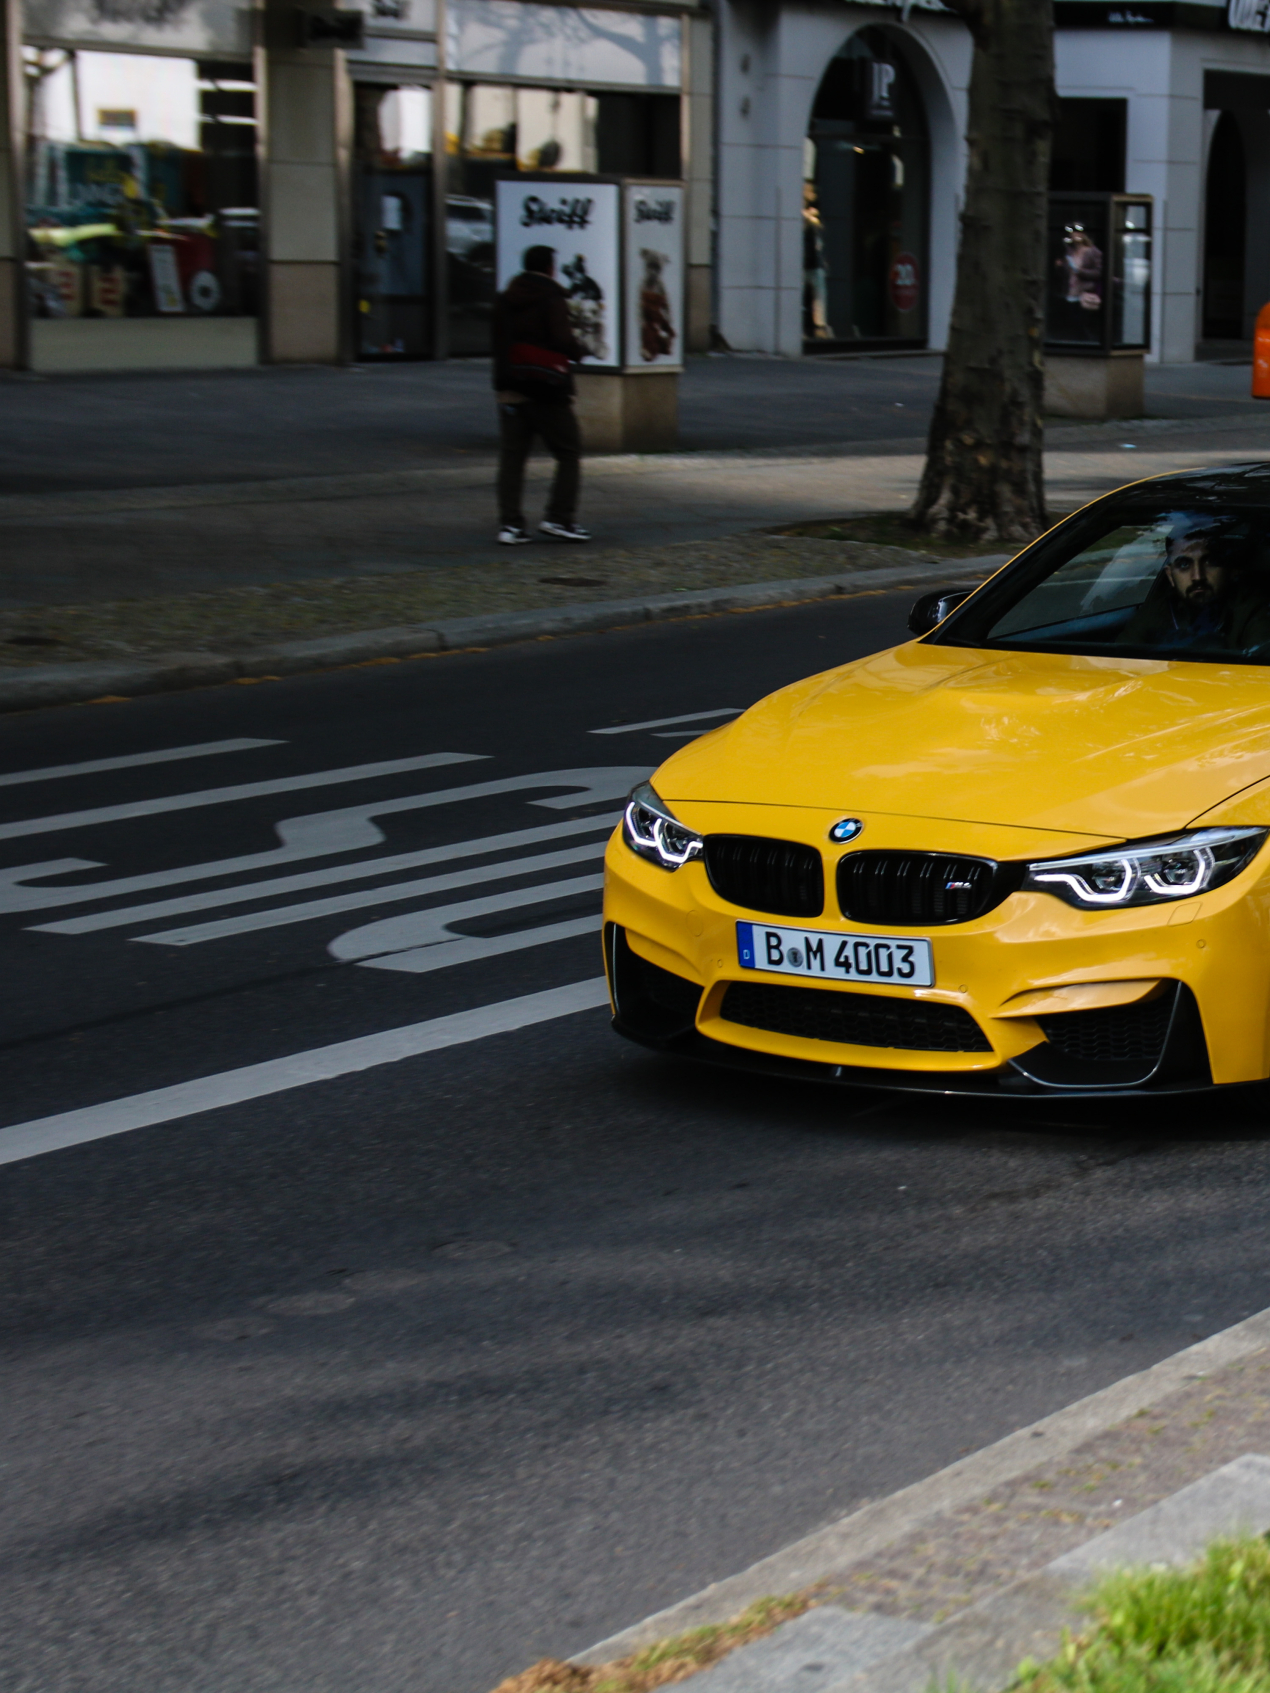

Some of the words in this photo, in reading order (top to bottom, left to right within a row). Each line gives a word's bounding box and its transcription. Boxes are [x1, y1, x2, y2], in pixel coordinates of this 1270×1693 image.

[764, 931, 784, 966] B
[805, 936, 825, 971] M
[834, 939, 915, 979] 4003
